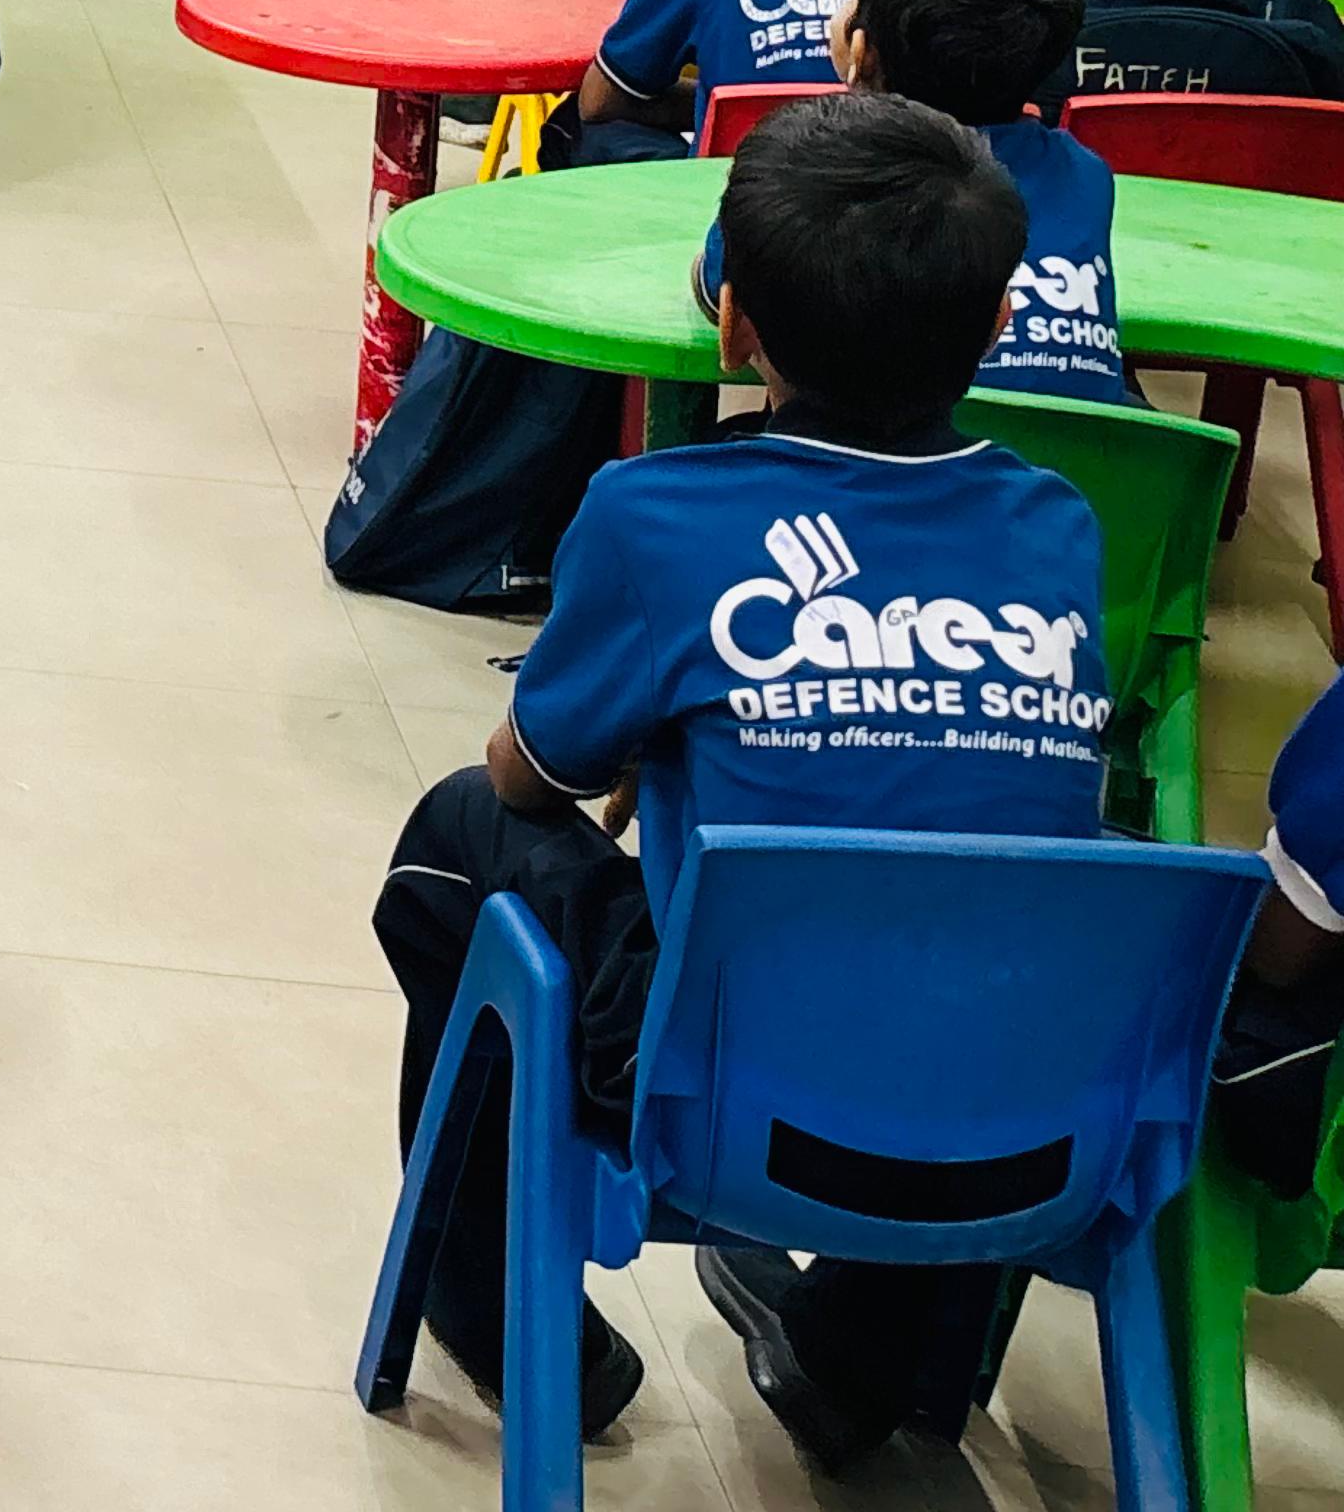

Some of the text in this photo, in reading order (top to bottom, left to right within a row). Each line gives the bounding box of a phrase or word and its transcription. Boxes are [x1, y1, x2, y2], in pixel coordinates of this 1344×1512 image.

[755, 47, 802, 69] Making
[1076, 46, 1210, 94] FATEH
[728, 678, 1113, 733] DEFENCE SCHOO
[740, 726, 821, 752] Making
